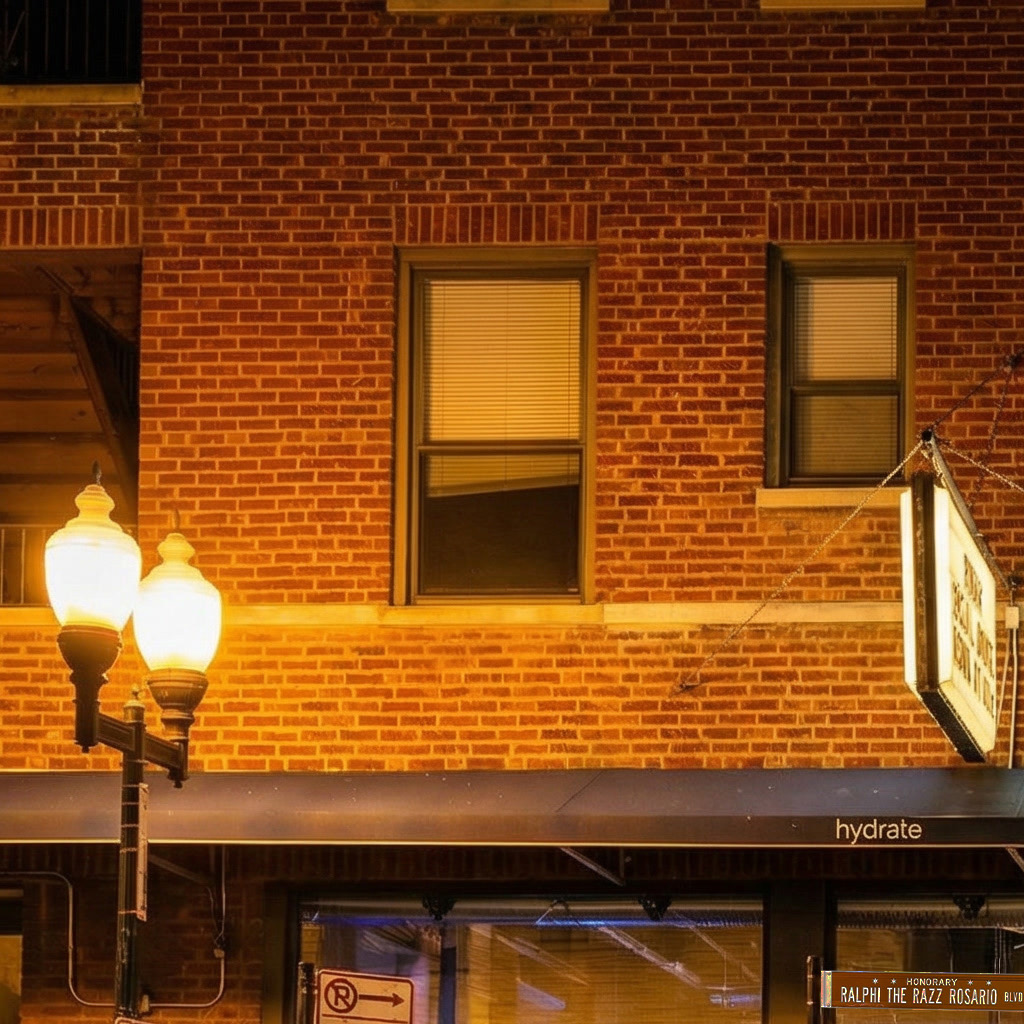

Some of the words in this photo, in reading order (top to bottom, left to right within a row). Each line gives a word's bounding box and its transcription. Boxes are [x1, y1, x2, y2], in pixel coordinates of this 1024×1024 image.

[836, 818, 923, 845] hydrate
[906, 977, 958, 987] HONORARY
[840, 986, 881, 1003] RALPHI
[886, 987, 907, 1004] THE
[912, 988, 943, 1005] RAZZ
[949, 988, 998, 1006] ROSARIO
[1004, 991, 1024, 1003] BLVD
